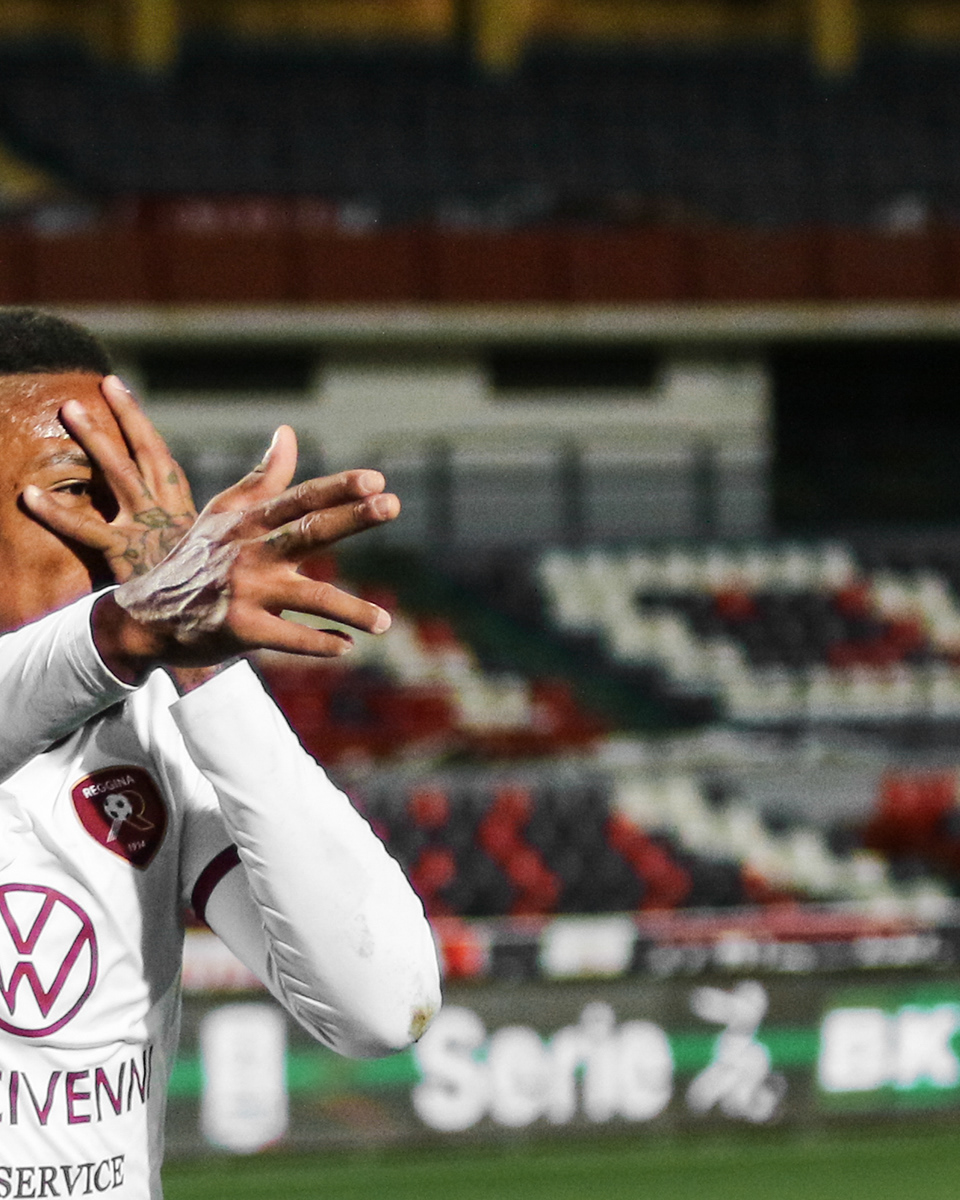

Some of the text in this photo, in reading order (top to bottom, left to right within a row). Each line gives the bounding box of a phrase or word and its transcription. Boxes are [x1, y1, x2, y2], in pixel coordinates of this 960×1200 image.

[82, 775, 135, 799] REGGINA
[127, 839, 146, 851] 1914
[413, 1002, 674, 1132] Serie
